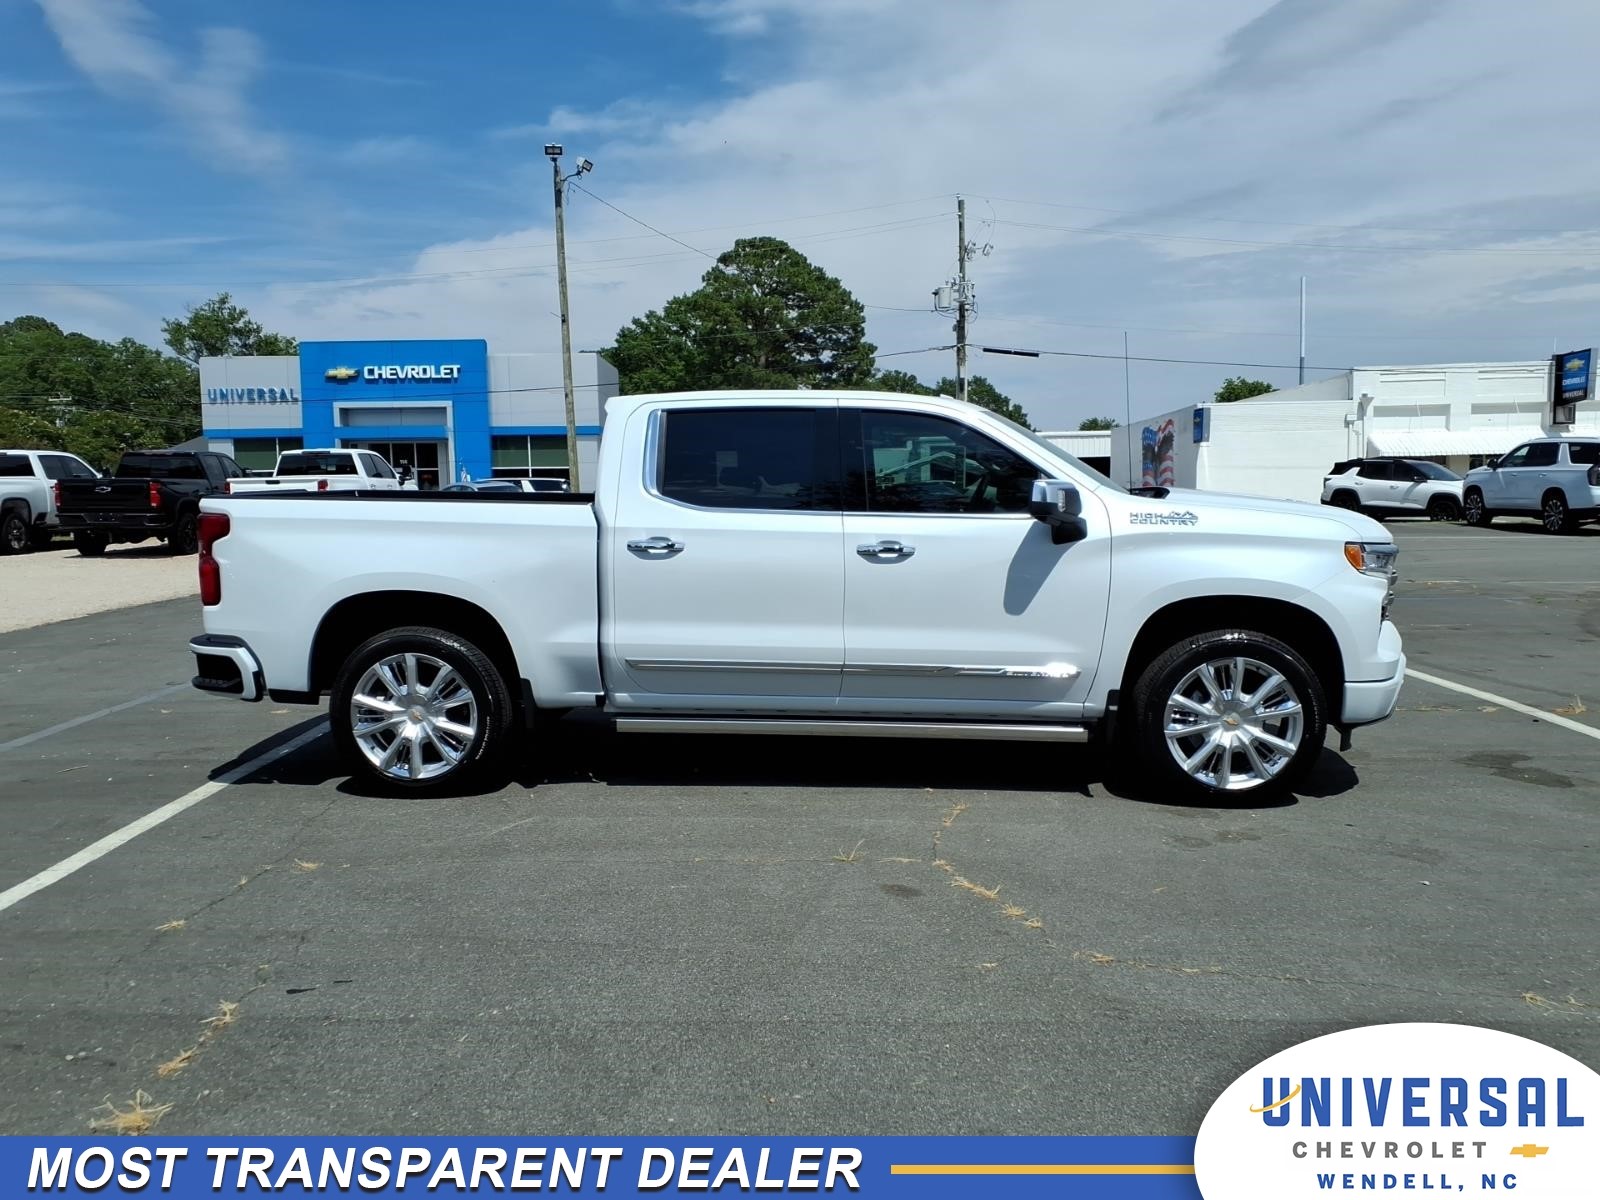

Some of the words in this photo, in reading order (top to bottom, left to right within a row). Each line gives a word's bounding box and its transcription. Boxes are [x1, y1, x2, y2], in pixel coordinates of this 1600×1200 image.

[363, 365, 461, 379] CHEVROLET
[208, 387, 298, 403] UNIVERSAL
[1129, 518, 1196, 526] COUNTRY
